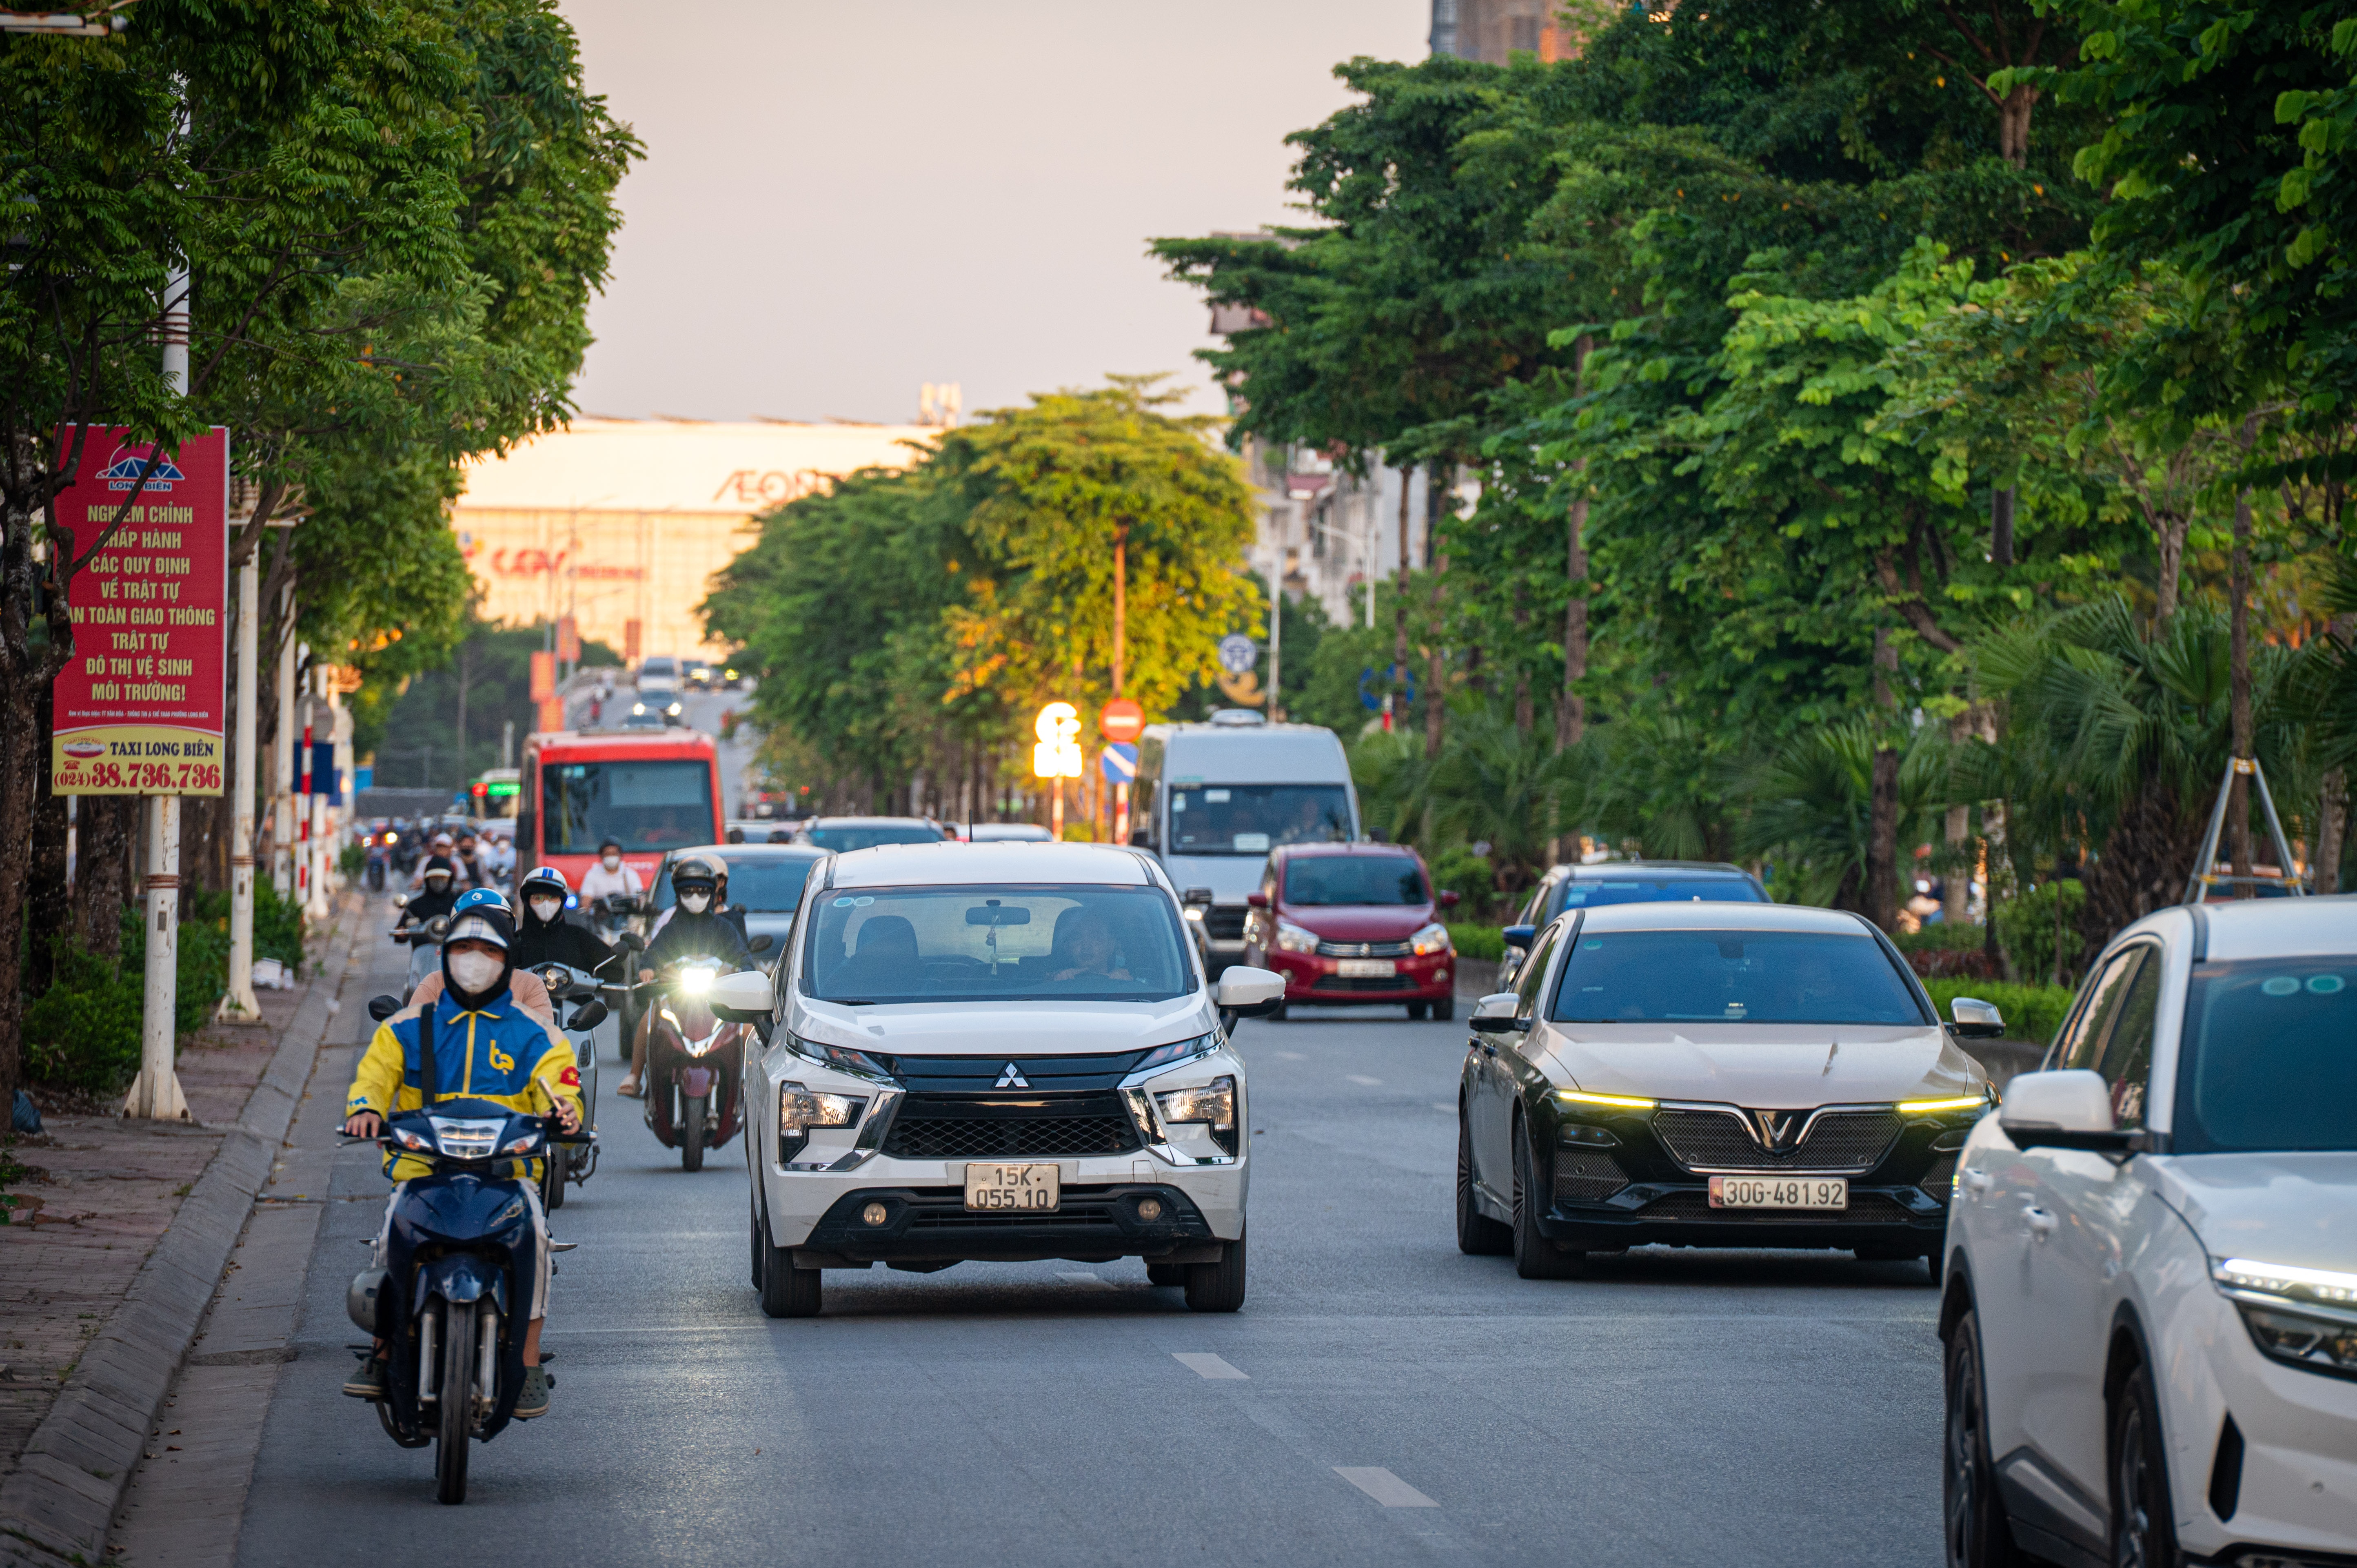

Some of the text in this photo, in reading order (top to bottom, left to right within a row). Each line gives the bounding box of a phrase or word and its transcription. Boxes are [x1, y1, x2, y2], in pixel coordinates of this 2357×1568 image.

[109, 480, 172, 491] LON BIÊN
[149, 501, 193, 523] CHỈNH
[142, 528, 181, 549] HÀNH
[90, 552, 190, 578] CÁC QUY ĐỊNH
[122, 579, 158, 603] TRẬT
[161, 581, 181, 603] TỰ
[89, 603, 126, 624] TOÀN
[131, 607, 164, 625] GIAO
[168, 605, 215, 626] THÔNG
[111, 630, 169, 654] TRẬT TỰ
[86, 654, 192, 679] ĐÔ THỊ VỆ SINH
[92, 680, 120, 700] MÔI
[111, 742, 141, 755] TAXI
[146, 742, 180, 756] LONG
[184, 739, 213, 756] BIÊN
[92, 762, 220, 789] 38.736.736
[996, 1167, 1031, 1186] 15K
[977, 1189, 1048, 1208] 055.10
[1726, 1182, 1843, 1205] 30G-481.92
